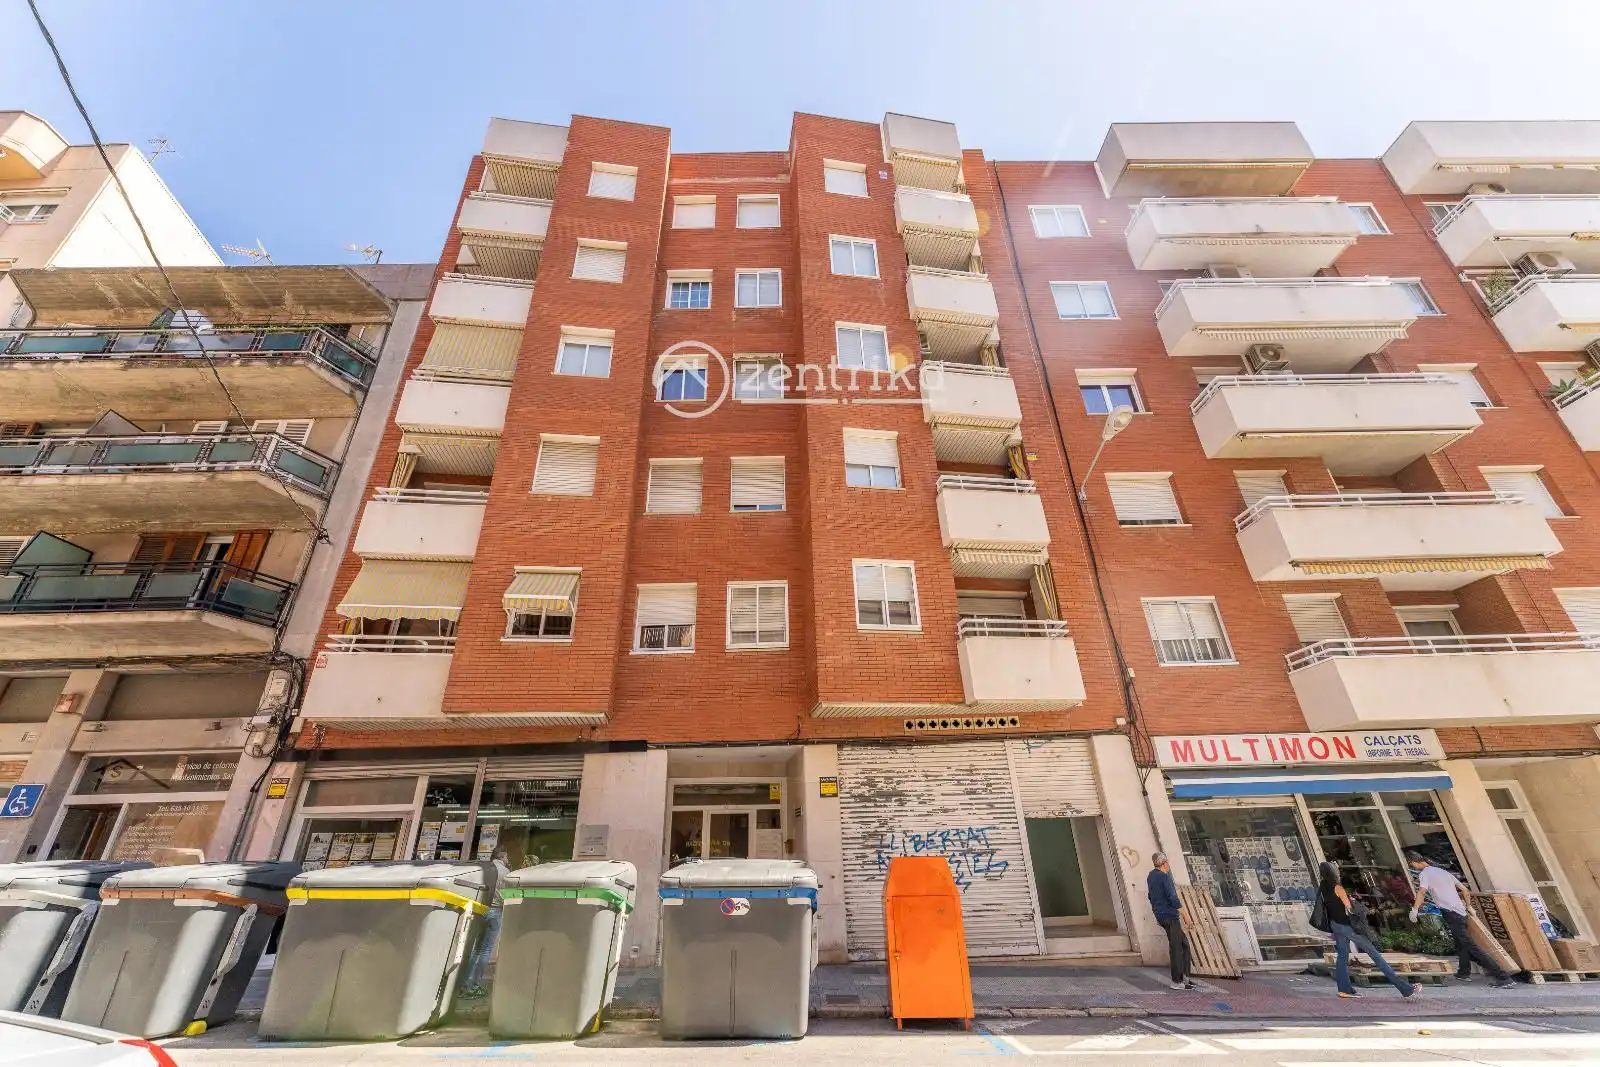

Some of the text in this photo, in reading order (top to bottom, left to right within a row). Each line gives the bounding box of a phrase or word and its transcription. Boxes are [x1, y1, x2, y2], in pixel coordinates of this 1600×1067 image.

[1363, 735, 1422, 747] CALÇATS
[1170, 735, 1357, 762] MULTIMON
[177, 761, 202, 770] Servicio
[202, 760, 212, 770] de
